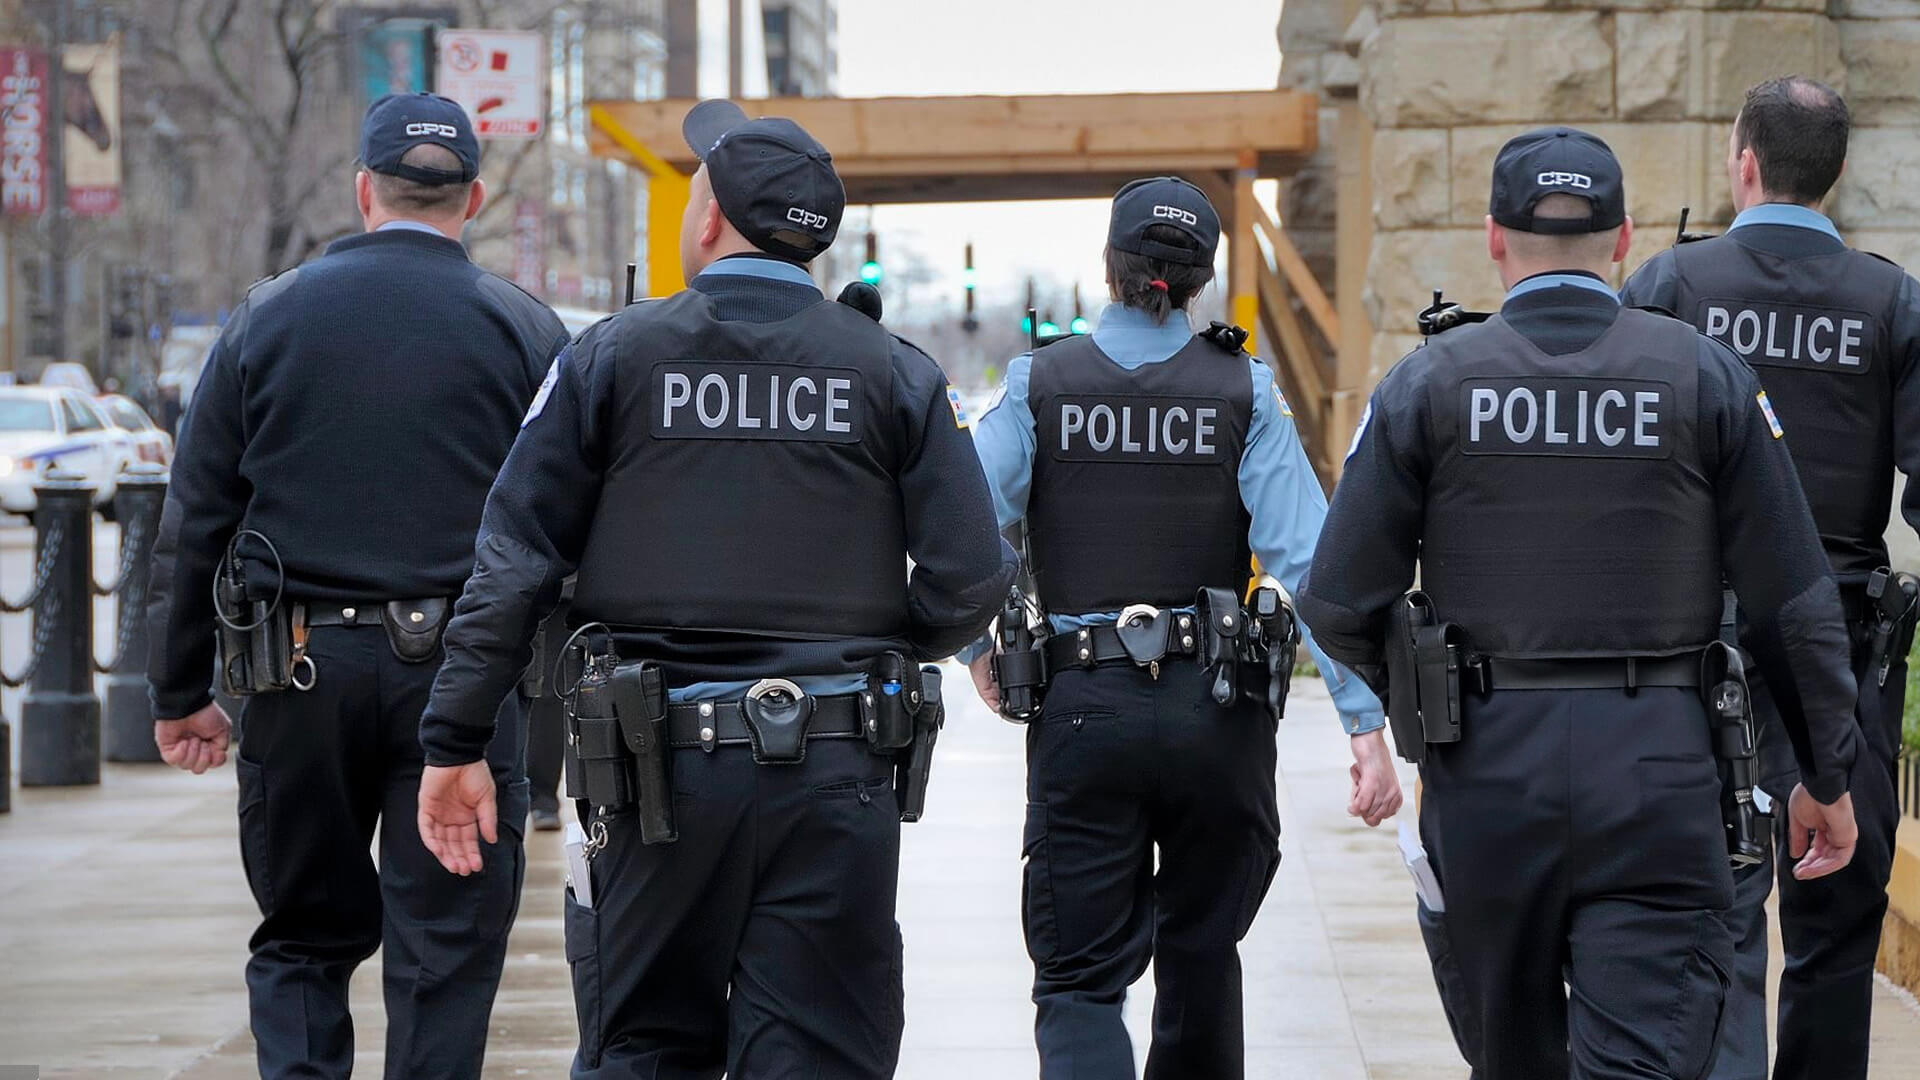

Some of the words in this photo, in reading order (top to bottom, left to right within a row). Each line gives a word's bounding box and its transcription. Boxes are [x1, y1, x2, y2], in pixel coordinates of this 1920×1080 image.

[2, 77, 40, 207] HORSE
[405, 121, 457, 139] CPD
[1537, 171, 1593, 190] CPD
[786, 206, 828, 230] CPD
[1153, 204, 1197, 226] CPD
[1706, 307, 1864, 366] POLICE
[662, 372, 852, 434] POLICE
[1060, 403, 1218, 456] POLICE
[1469, 386, 1660, 447] POLICE
